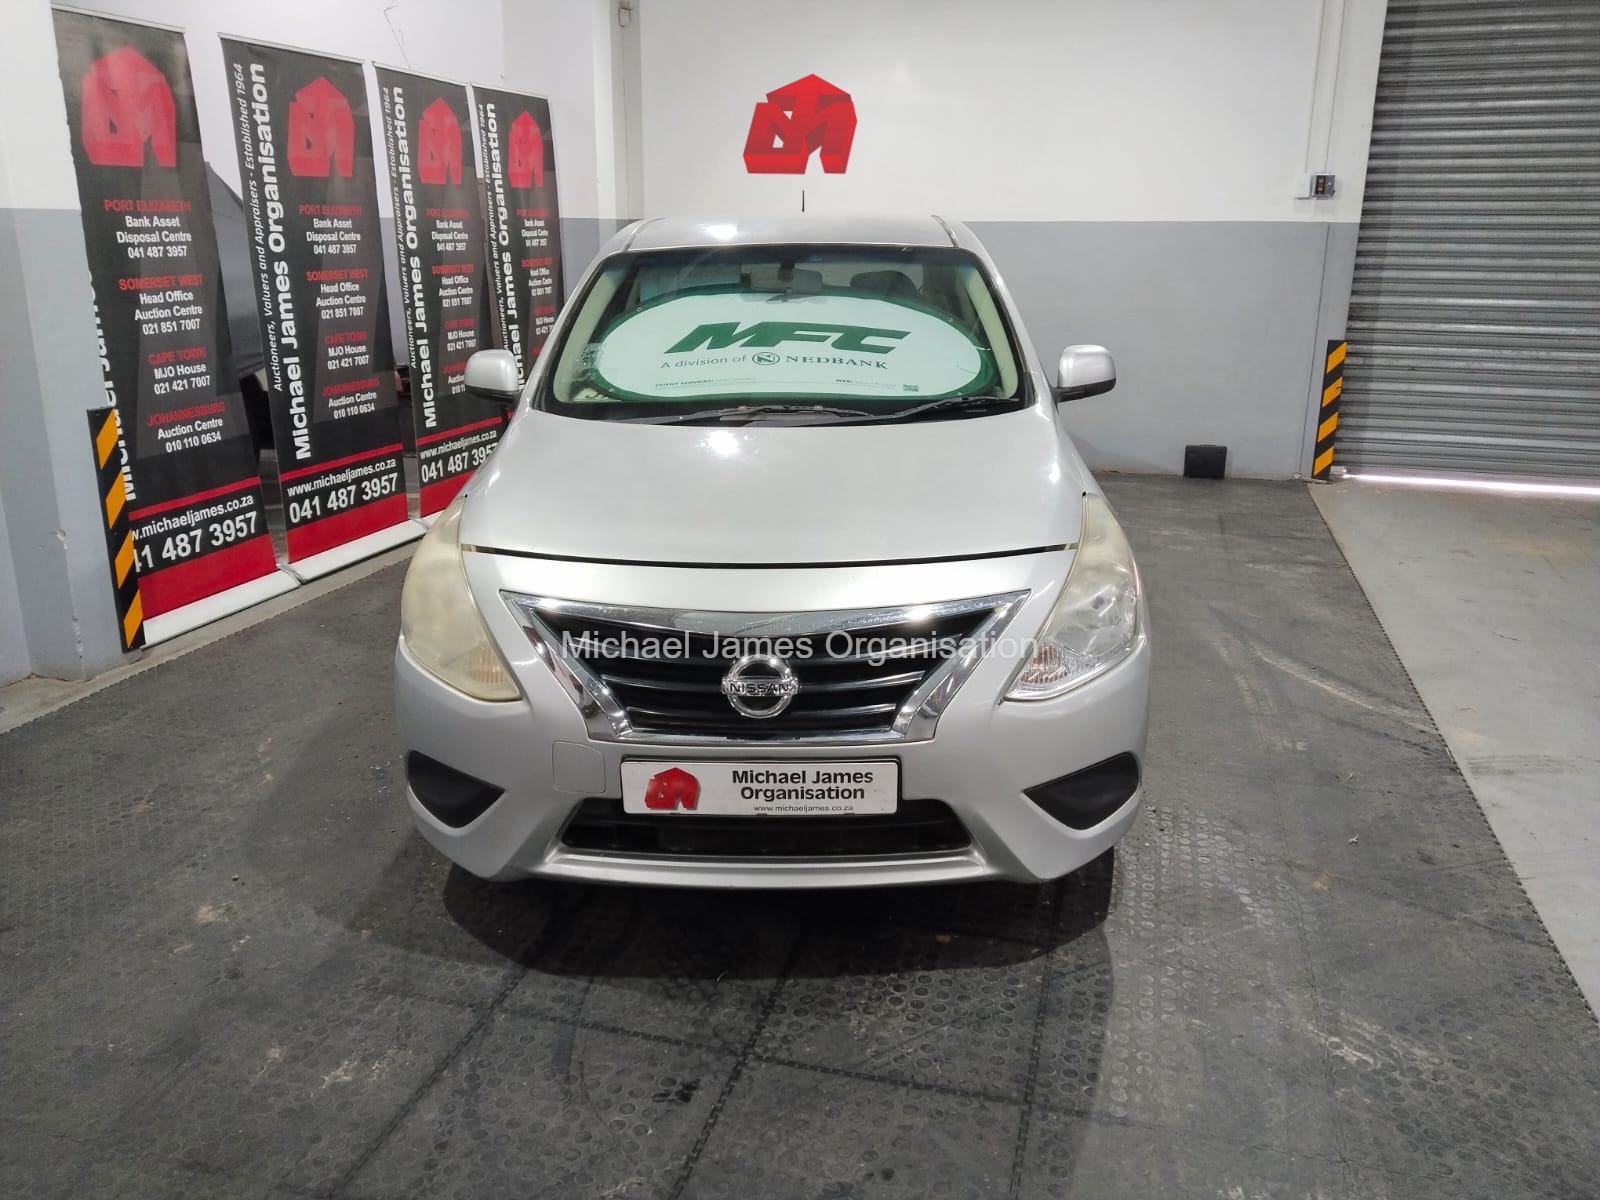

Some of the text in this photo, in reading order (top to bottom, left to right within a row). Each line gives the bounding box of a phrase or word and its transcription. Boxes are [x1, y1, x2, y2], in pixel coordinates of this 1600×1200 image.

[237, 98, 255, 170] Established
[487, 103, 509, 246] Organisation
[104, 200, 133, 212] PORT
[249, 180, 264, 244] Appraisers
[125, 215, 180, 228] Bank Asset
[313, 219, 352, 229] Bank Asset
[116, 230, 192, 246] Disposal Centre
[306, 231, 360, 245] Disposal Centre
[128, 245, 187, 258] 041 487 3957
[256, 246, 267, 270] and
[393, 87, 437, 428] Michael James Organisation
[250, 63, 312, 460] Michael James Organisation
[119, 276, 175, 291] SOMERSET
[320, 282, 360, 294] Head Office
[502, 251, 518, 319] James
[139, 290, 193, 305] Head Office
[261, 273, 273, 316] Valuers
[316, 295, 367, 308] Auction Centre
[135, 305, 202, 321] Auction Centre
[143, 319, 200, 335] 021 851 7007
[663, 320, 912, 355] MFC
[267, 321, 282, 391] Auctioneers,
[347, 344, 367, 355] House
[149, 352, 175, 366] CAPE
[660, 354, 889, 370] A division of NEDBANK
[154, 363, 206, 381] MJO House
[154, 376, 211, 396] 021 421 7007
[328, 391, 378, 409] Auction Centre
[158, 418, 223, 441] Auction Centre
[166, 431, 222, 454] 010 110 0634
[421, 459, 444, 483] 041
[447, 451, 468, 473] 487
[287, 459, 397, 498] www.michaeljames.co.za
[289, 472, 399, 524] 041 487 3957
[161, 529, 203, 562] 487
[209, 511, 257, 547] 3957
[729, 683, 790, 693] NISSAN
[732, 769, 874, 785] Michael James
[740, 785, 865, 802] Organisation
[753, 803, 854, 814] www.michaeljames.co.za
